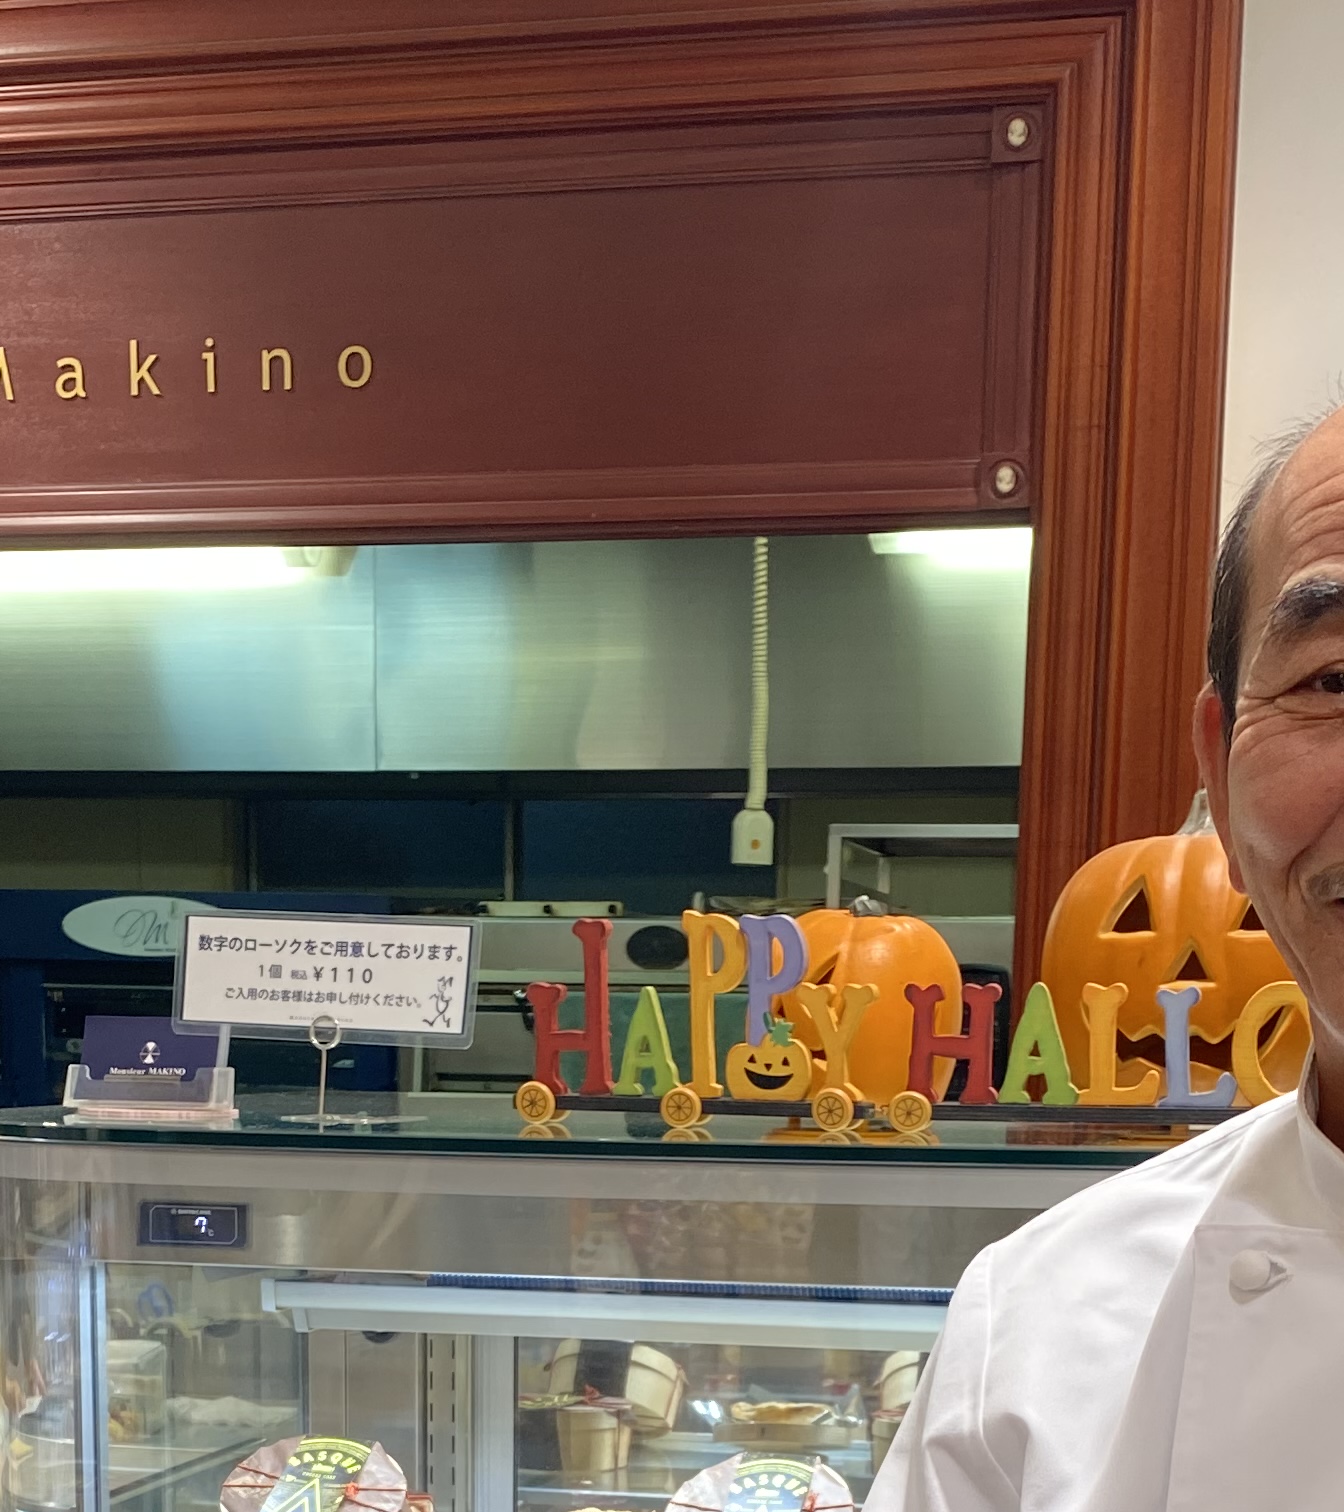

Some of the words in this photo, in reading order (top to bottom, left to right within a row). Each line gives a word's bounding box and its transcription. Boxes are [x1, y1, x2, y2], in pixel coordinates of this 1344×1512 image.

[198, 934, 463, 962] 数字のローソクをご用意しております。
[258, 964, 283, 979] 1個
[225, 987, 422, 1009] ご入用のお客様はお申し付けください。
[525, 908, 879, 1098] HAPPY
[903, 980, 1311, 1108] HALLO
[147, 1067, 187, 1076] MAKINO
